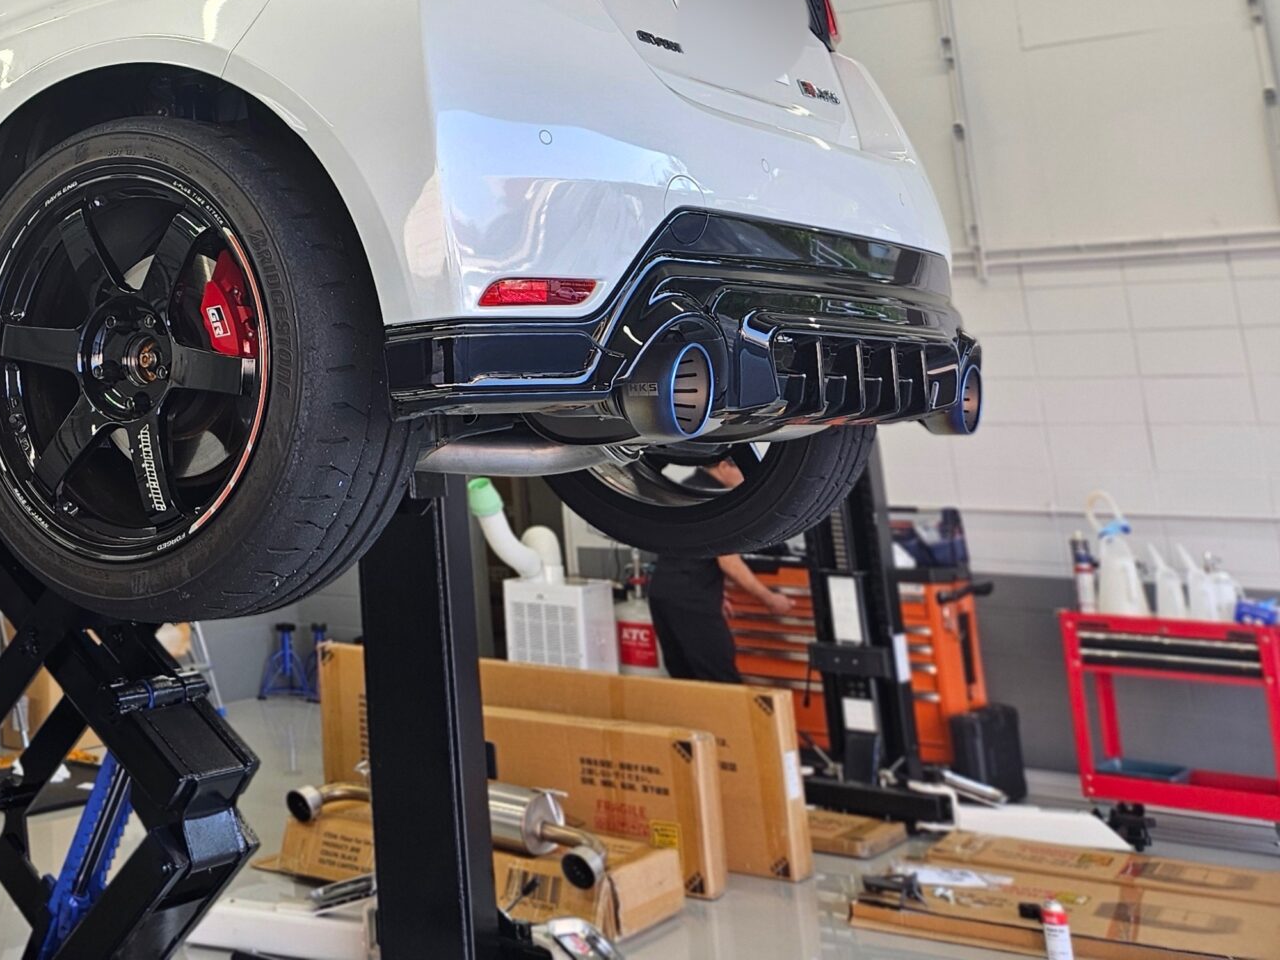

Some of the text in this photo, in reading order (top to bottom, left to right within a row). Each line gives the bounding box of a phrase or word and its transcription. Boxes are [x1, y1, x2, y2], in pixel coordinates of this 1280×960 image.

[207, 307, 225, 336] GR
[249, 229, 294, 401] BRIDGESTONE
[629, 383, 657, 392] HKS
[157, 532, 186, 551] FORGED
